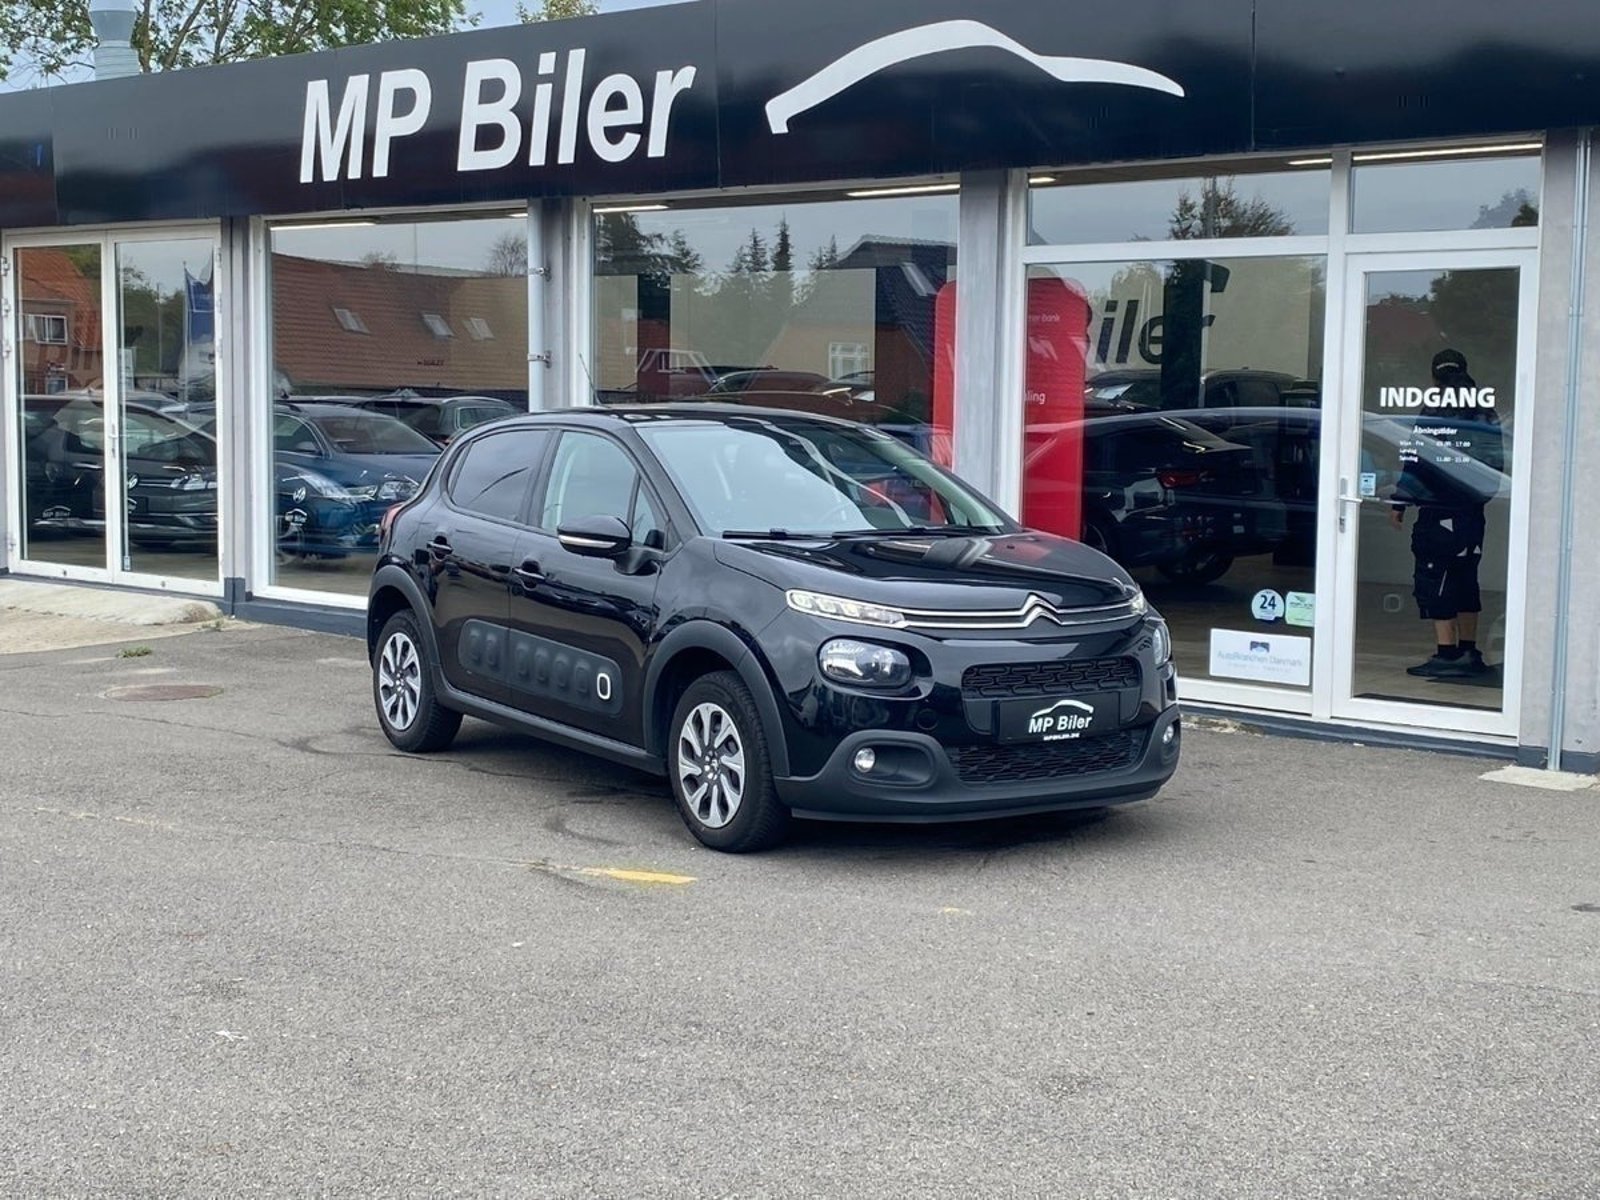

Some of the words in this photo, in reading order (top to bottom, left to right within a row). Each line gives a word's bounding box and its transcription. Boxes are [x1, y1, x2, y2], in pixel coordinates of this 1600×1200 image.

[300, 68, 432, 184] MP
[457, 48, 697, 171] Biler
[1027, 389, 1046, 404] ling
[1379, 386, 1496, 408] INDGANG
[1260, 594, 1276, 610] 24
[1028, 717, 1054, 733] MP
[1057, 715, 1092, 730] Biler
